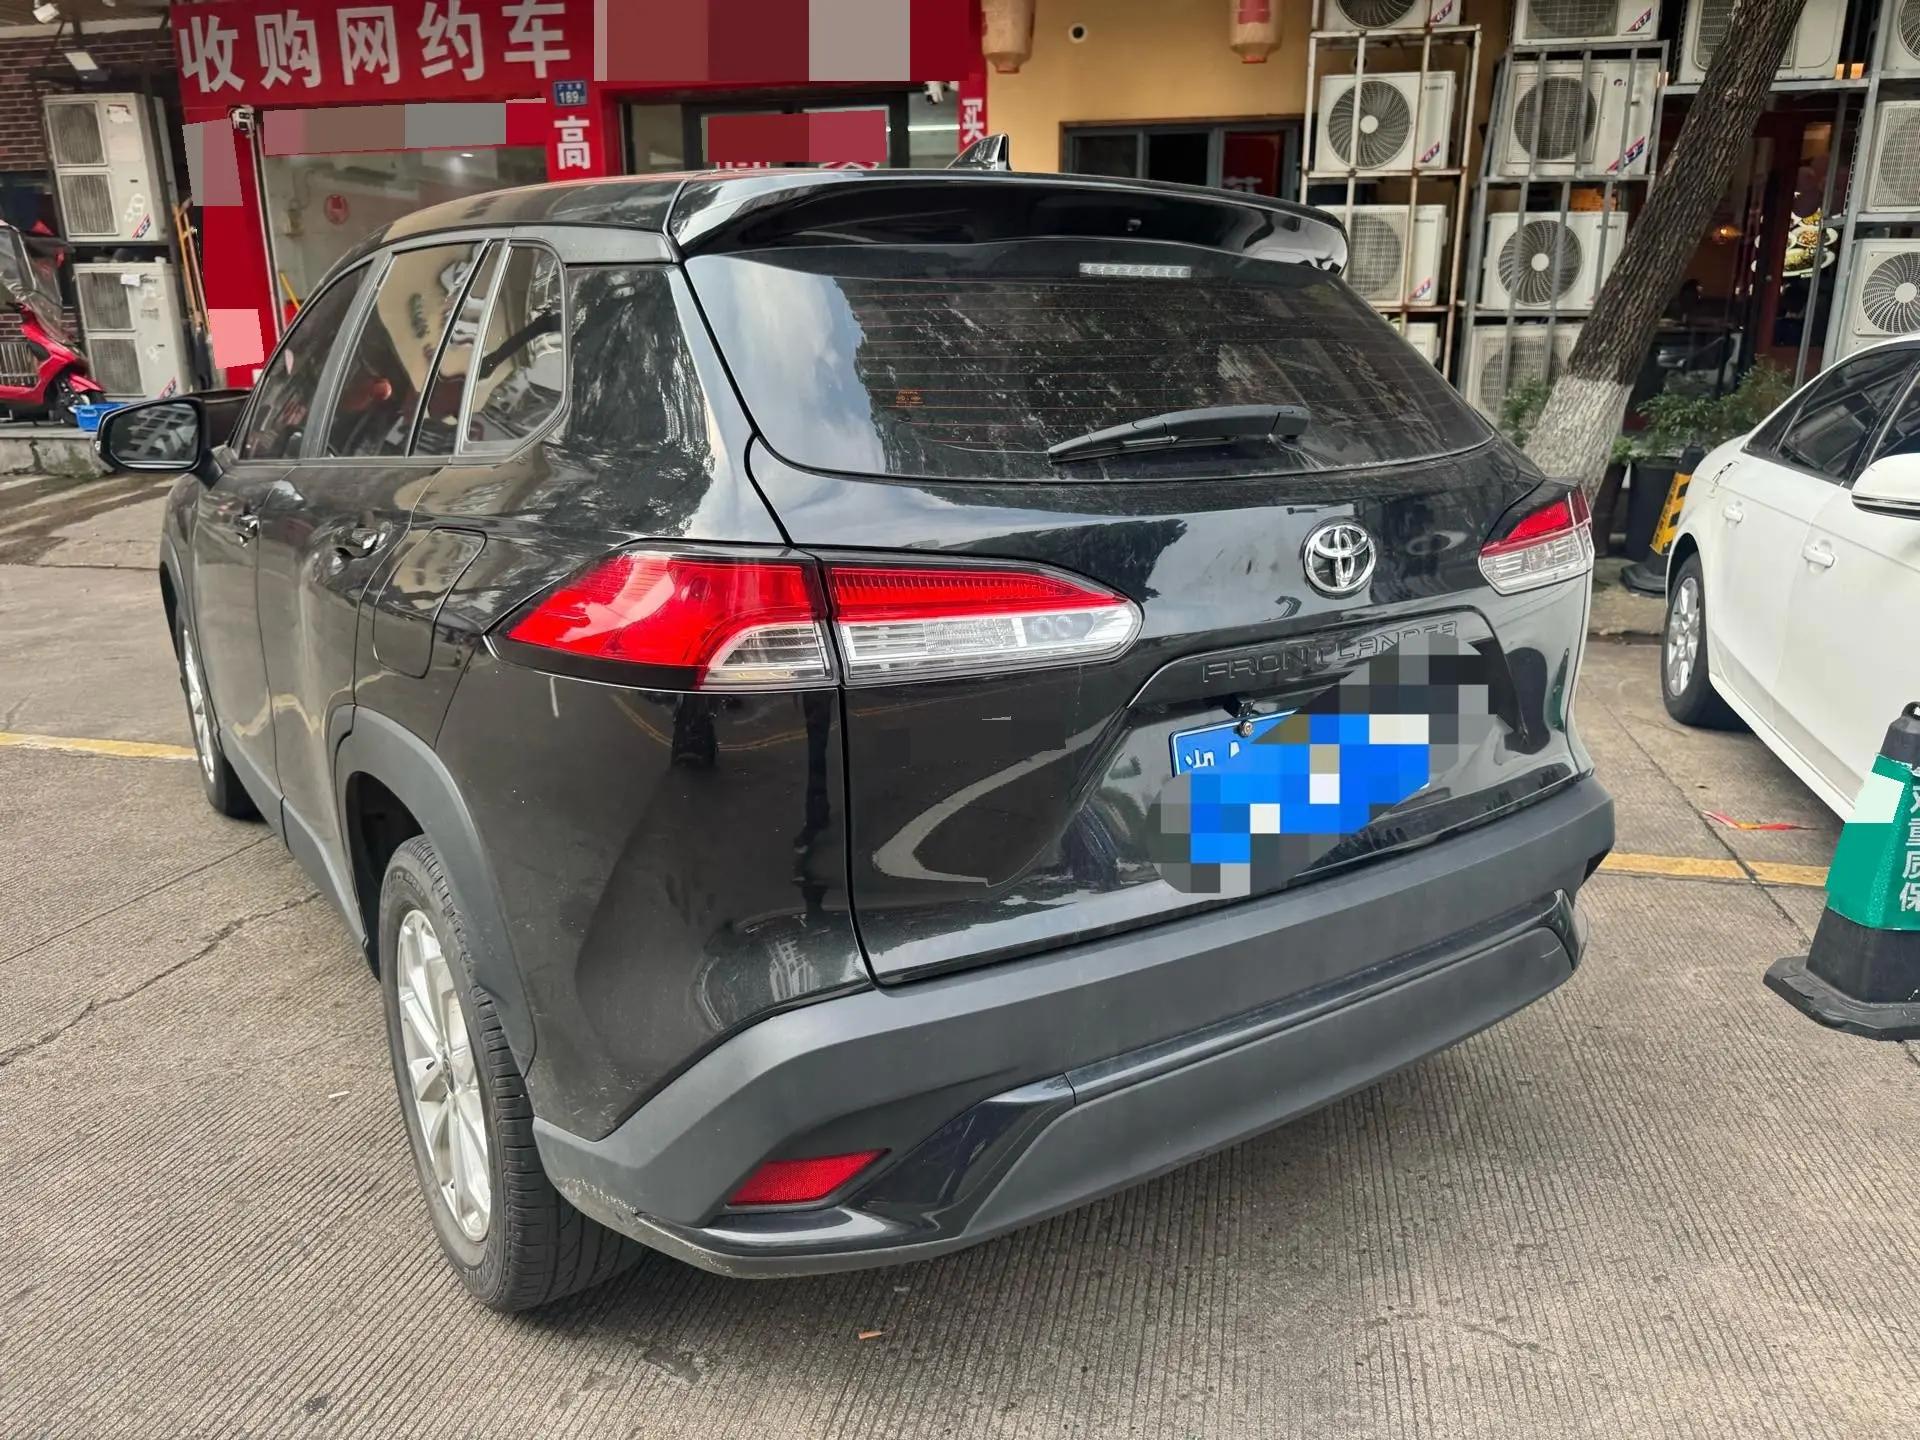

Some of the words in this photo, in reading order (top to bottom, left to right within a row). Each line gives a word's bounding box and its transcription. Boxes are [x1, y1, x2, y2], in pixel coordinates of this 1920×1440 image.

[178, 0, 571, 92] 收购网约车
[554, 115, 590, 170] 高
[962, 98, 985, 144] 买
